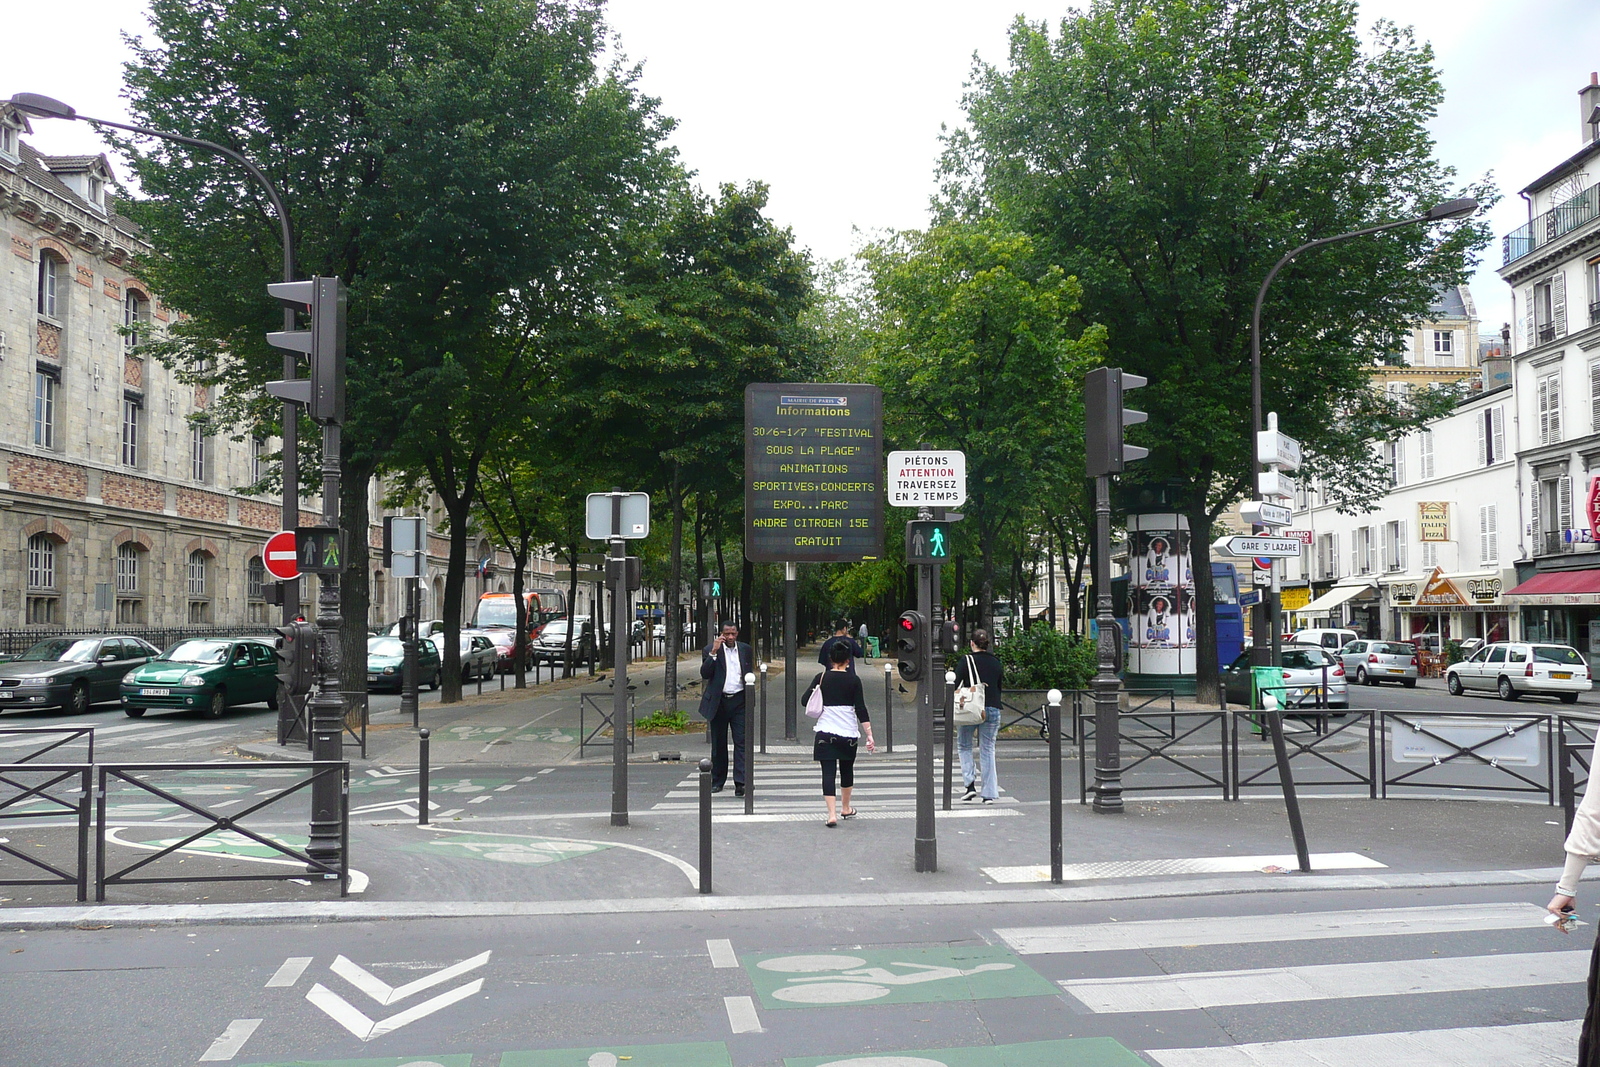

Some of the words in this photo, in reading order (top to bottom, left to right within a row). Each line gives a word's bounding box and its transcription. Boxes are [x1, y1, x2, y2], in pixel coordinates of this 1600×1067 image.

[776, 405, 851, 416] Informations
[752, 427, 807, 437] 30/6-1/7
[814, 428, 874, 438] "FESTIVAL
[766, 445, 794, 455] SOUS
[800, 446, 814, 455] LA
[820, 446, 860, 456] PLAGE"
[904, 455, 948, 465] PIÉTONS
[780, 464, 848, 473] ANIMATIONS
[900, 468, 954, 477] ATTENTION
[897, 480, 957, 489] TRAVERSEZ
[895, 492, 909, 501] EN
[913, 492, 919, 501] 2
[924, 492, 959, 501] TEMPS
[753, 518, 788, 528] ANDRE
[794, 518, 842, 528] CITROEN
[849, 518, 869, 528] 15E
[794, 536, 843, 546] GRATUIT
[1241, 542, 1260, 550] GARE
[1271, 543, 1297, 551] LAZARE
